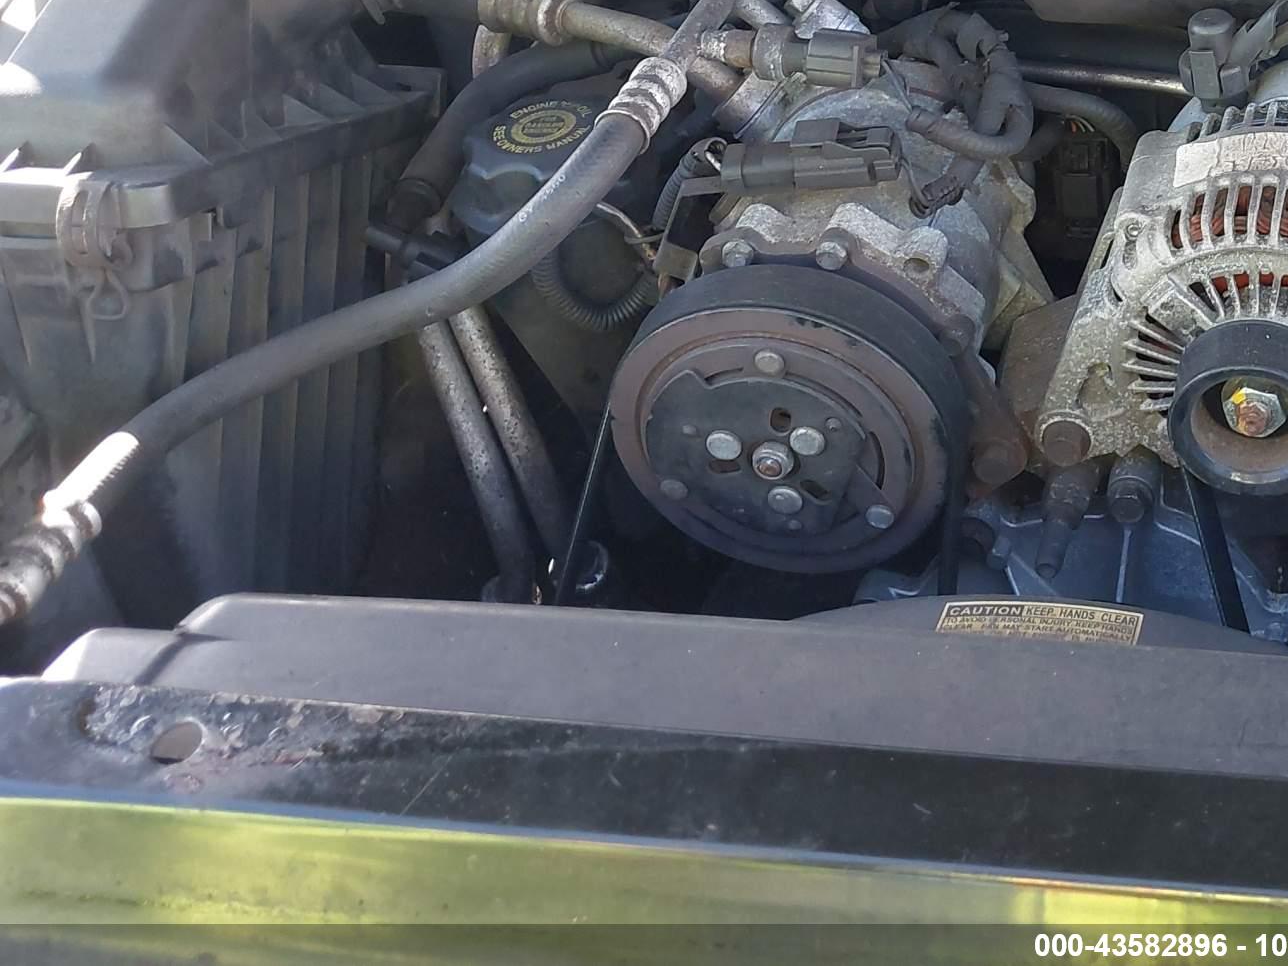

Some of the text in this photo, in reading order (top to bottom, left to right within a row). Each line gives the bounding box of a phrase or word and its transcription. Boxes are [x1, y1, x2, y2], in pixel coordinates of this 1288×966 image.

[510, 101, 558, 119] ENGINE
[493, 125, 506, 141] SEE
[496, 140, 542, 154] OWNERS
[949, 605, 1136, 626] CAUTION KEEP HANDS CLEAR
